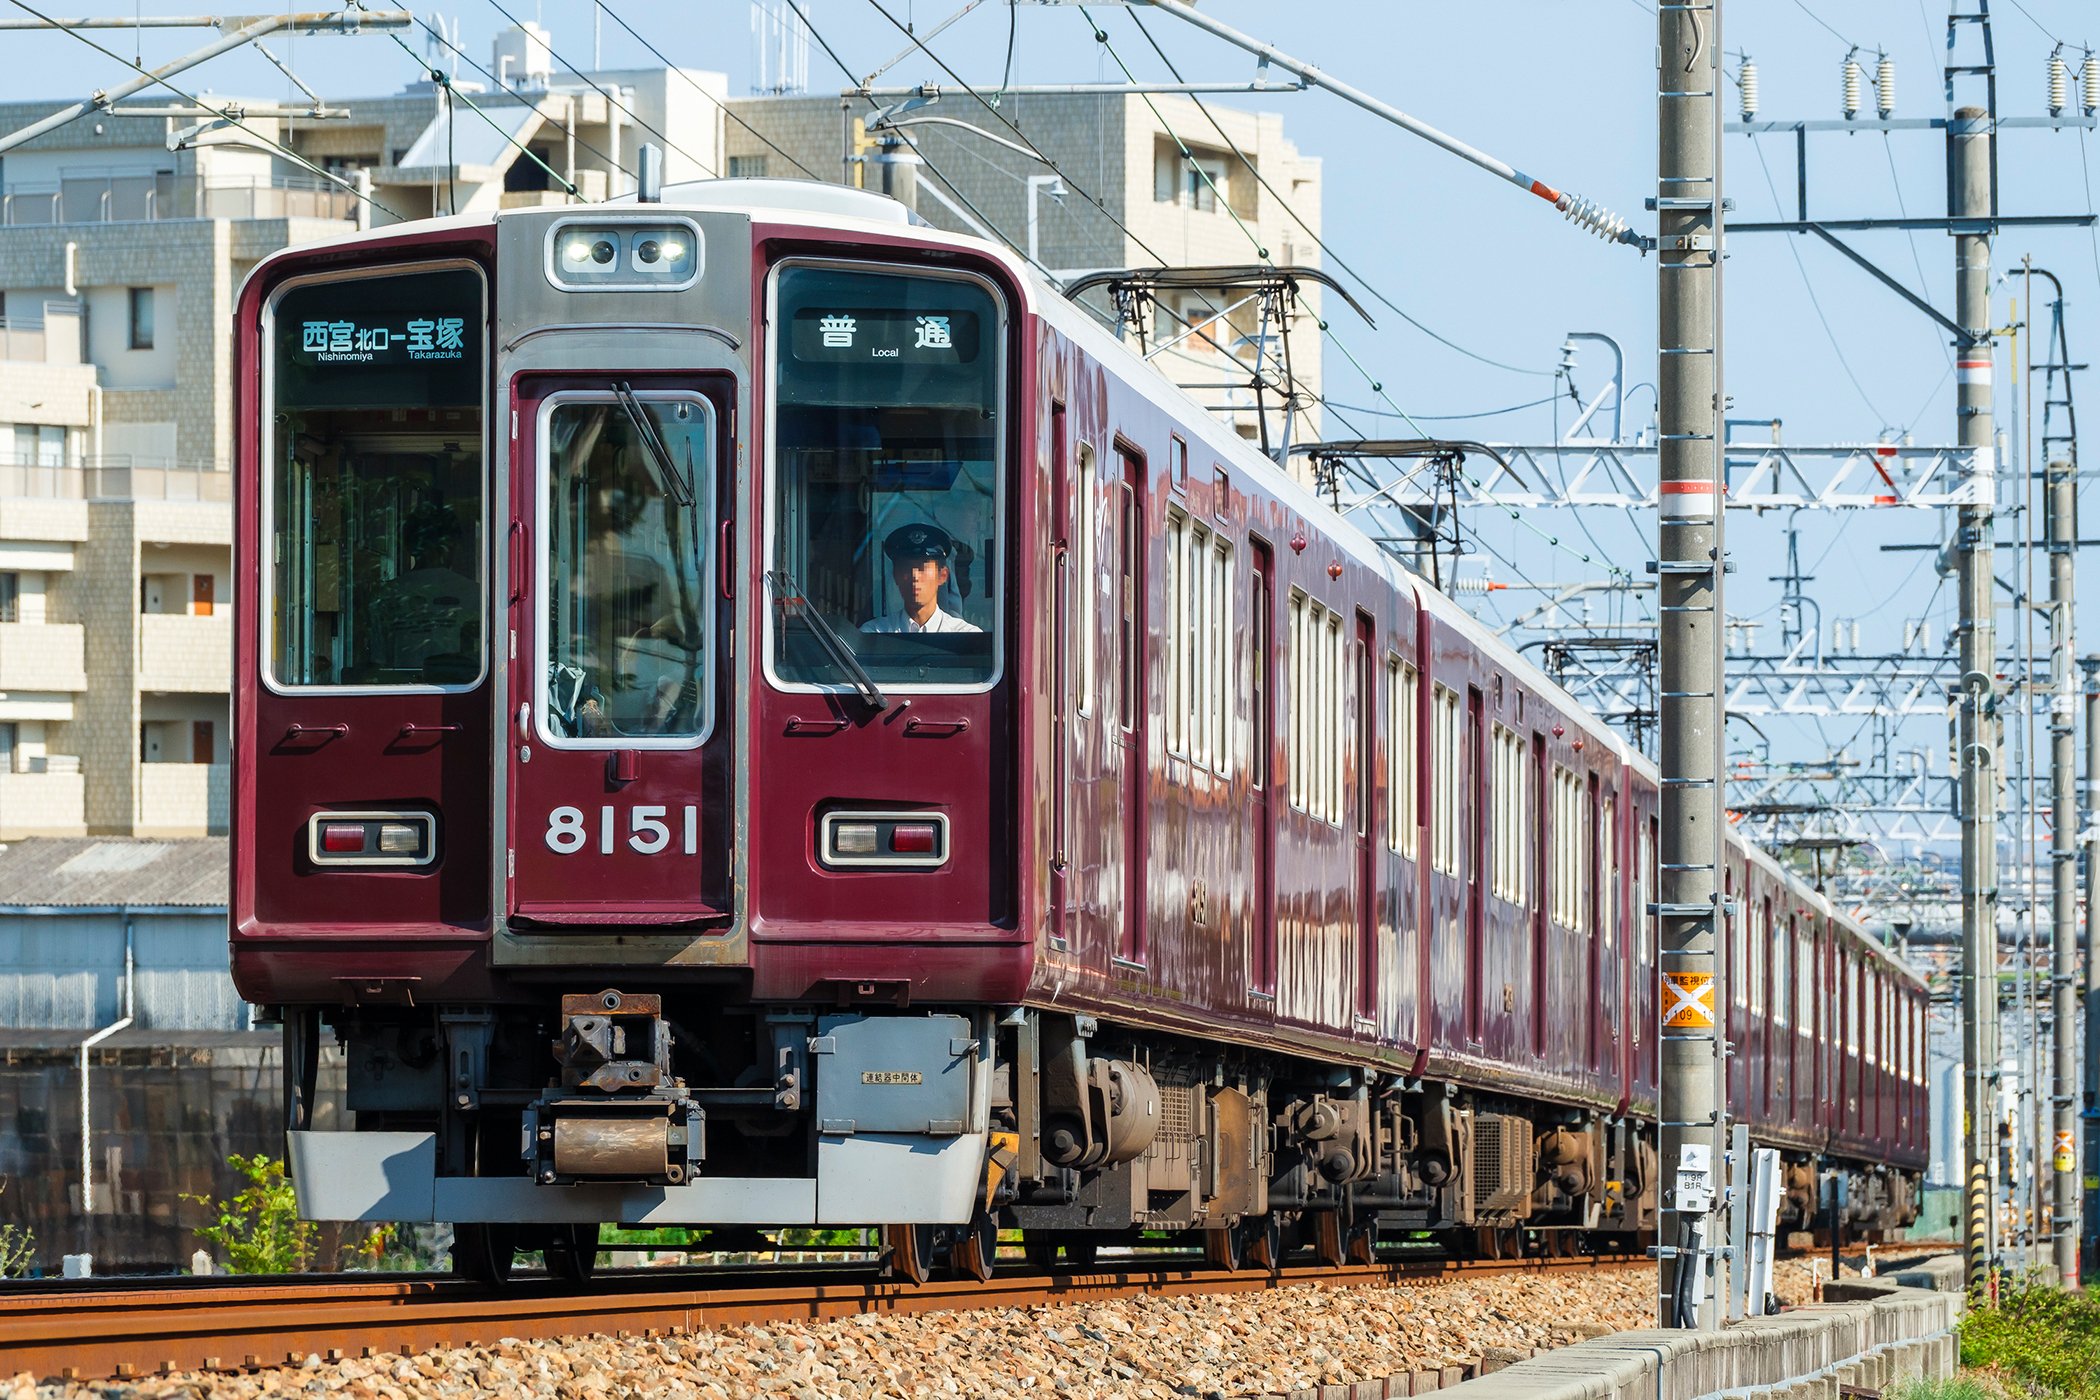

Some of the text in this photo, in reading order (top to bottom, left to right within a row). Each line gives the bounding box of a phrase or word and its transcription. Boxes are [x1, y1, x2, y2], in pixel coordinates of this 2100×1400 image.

[819, 314, 953, 349] 普通
[318, 350, 462, 362] Nishinomiya Takarazuka
[872, 347, 899, 357] Local
[545, 805, 697, 855] 8151
